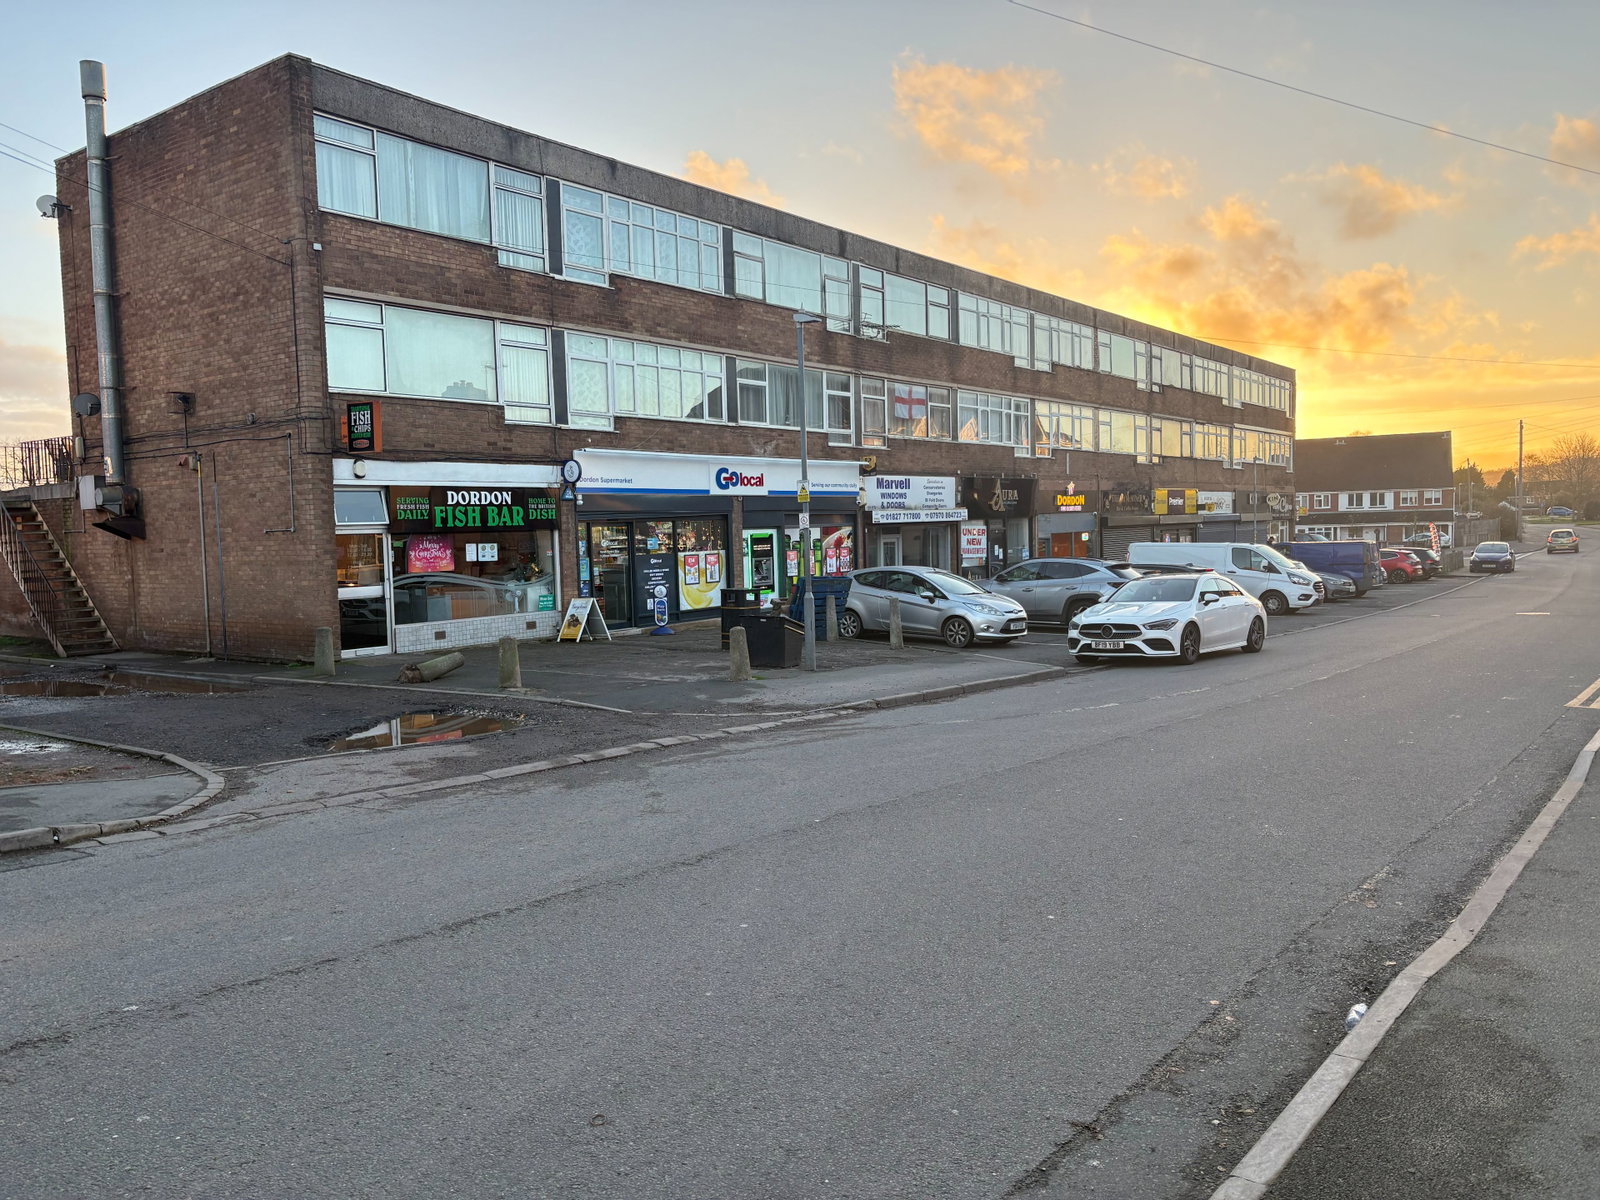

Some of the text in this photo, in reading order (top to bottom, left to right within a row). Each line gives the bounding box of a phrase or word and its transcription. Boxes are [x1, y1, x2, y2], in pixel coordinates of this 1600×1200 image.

[351, 411, 370, 425] FISH
[876, 477, 911, 490] Marvell
[446, 490, 512, 505] DORDON
[1057, 494, 1085, 505] DORDON
[886, 501, 906, 509] DOORS
[396, 509, 429, 520] DAILY
[434, 505, 525, 527] FISH BAR
[529, 509, 556, 519] DISH
[886, 512, 902, 520] 01827
[903, 512, 921, 520] 717800
[962, 528, 986, 537] UNDER
[966, 538, 982, 546] NEW
